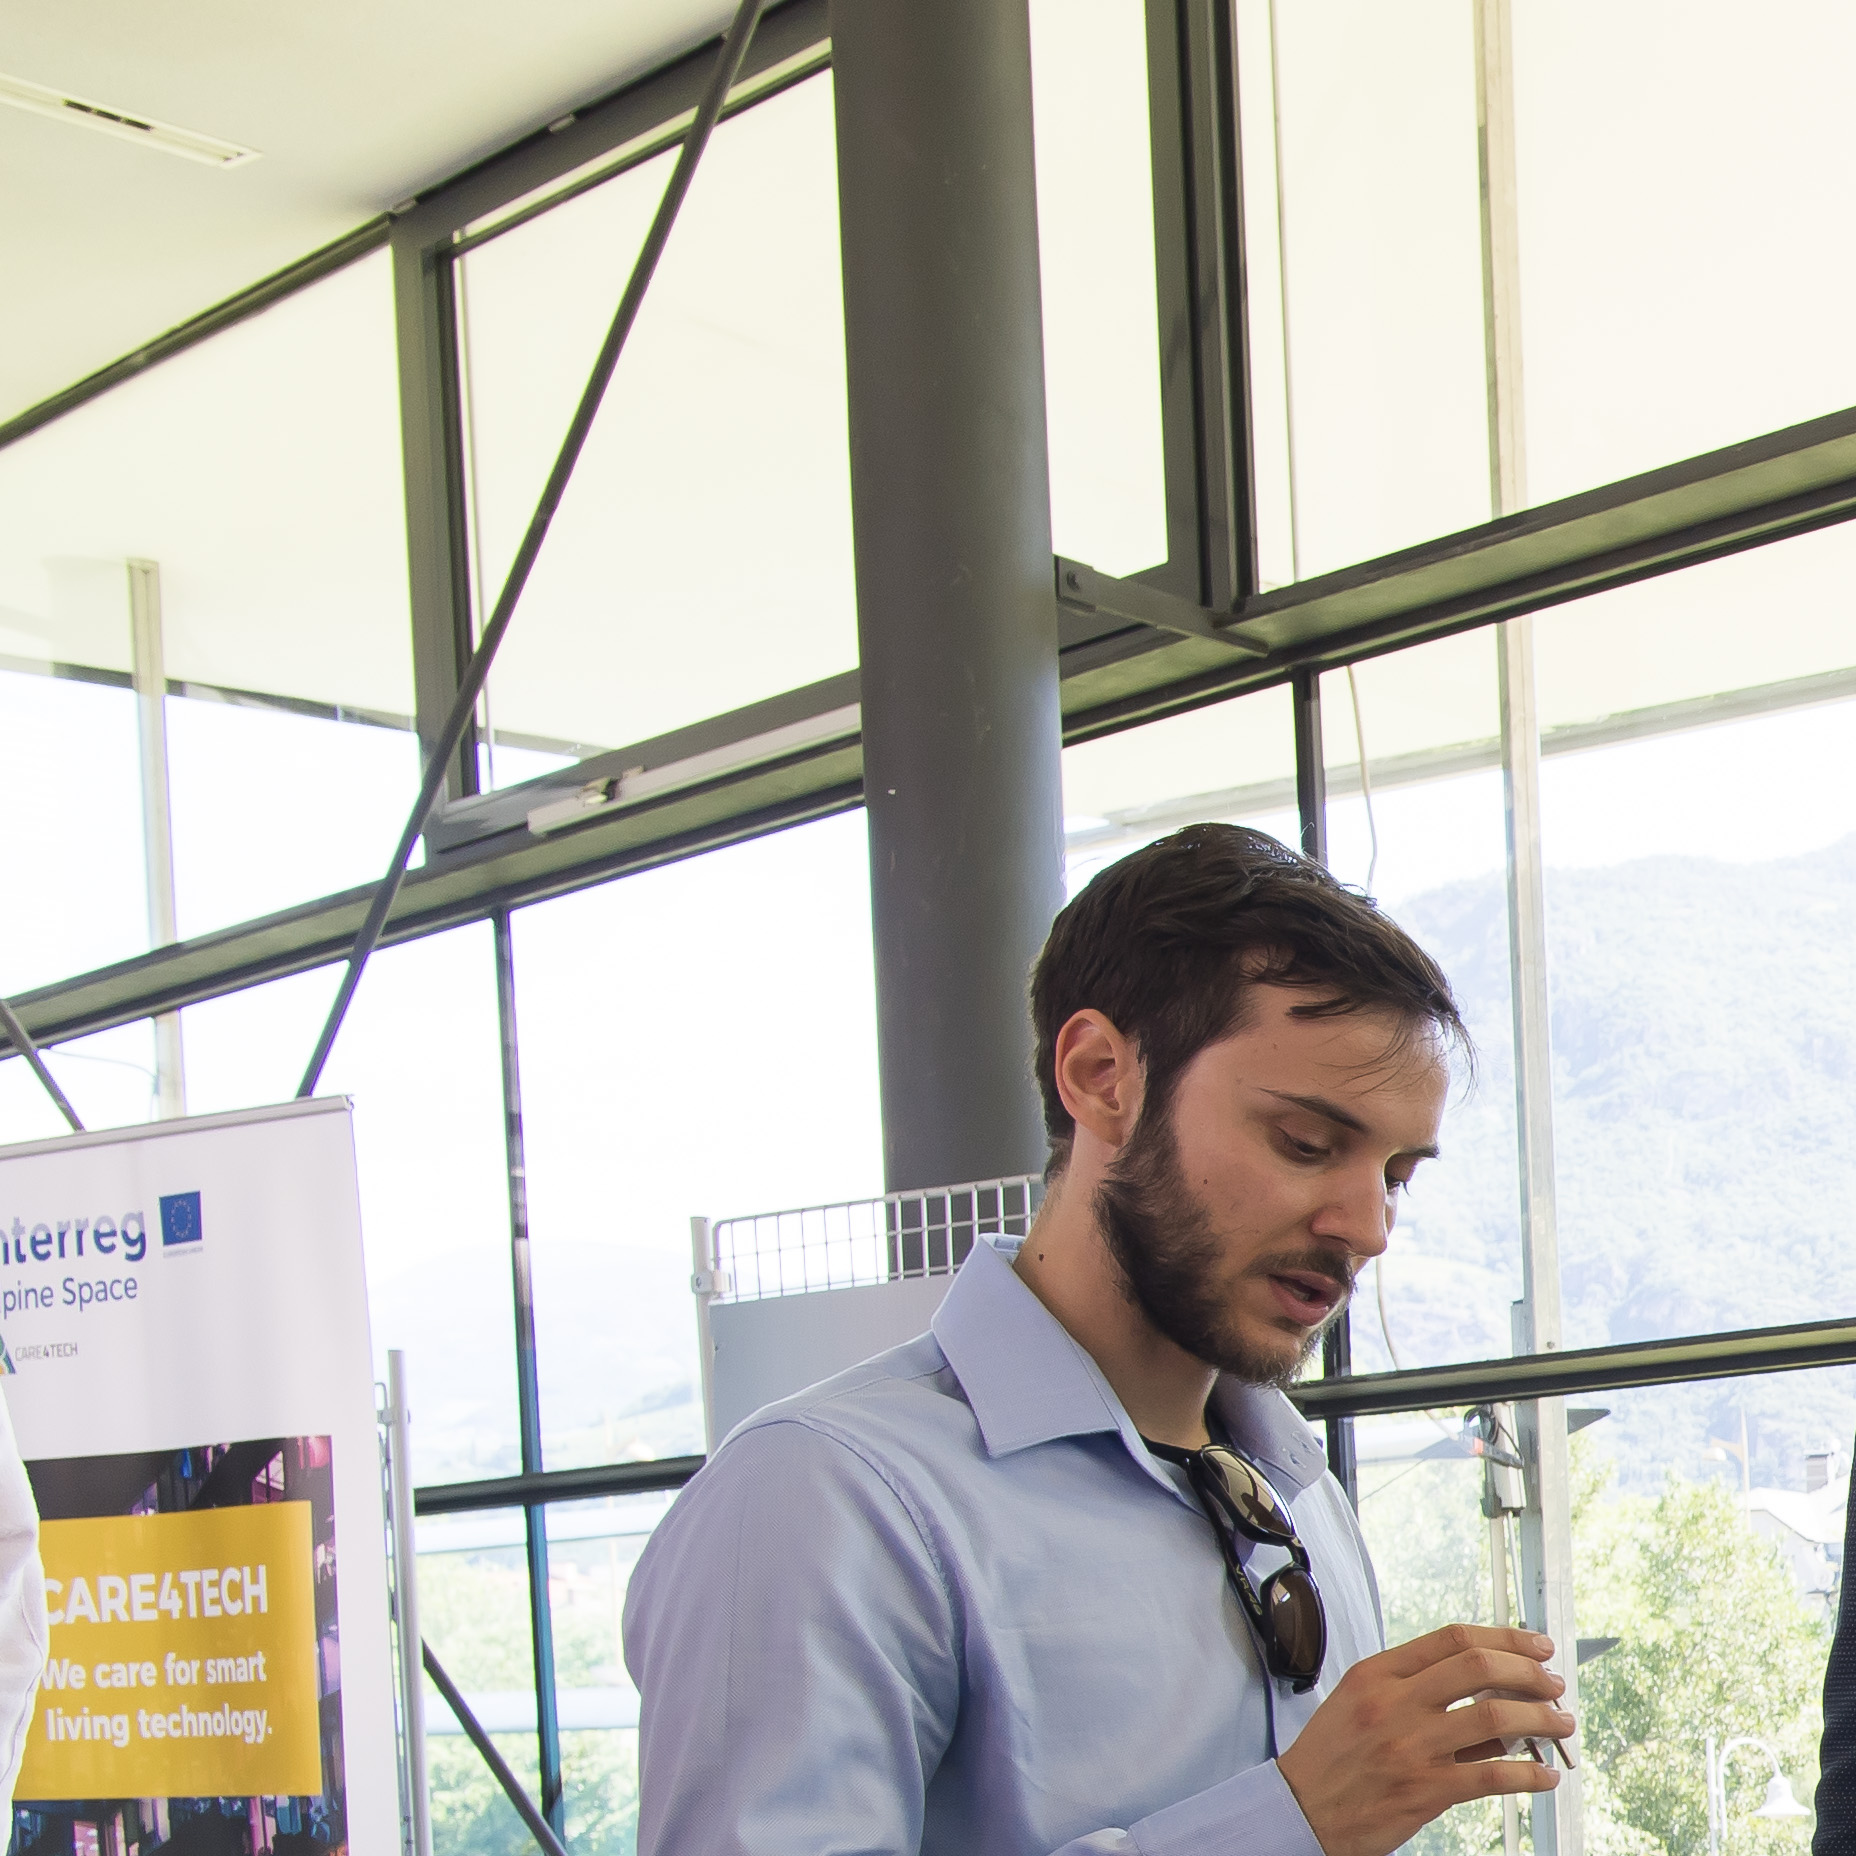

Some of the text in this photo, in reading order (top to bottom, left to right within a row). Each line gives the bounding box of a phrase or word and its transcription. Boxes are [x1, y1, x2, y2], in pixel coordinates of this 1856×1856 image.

[0, 1211, 147, 1264] terreg
[3, 1277, 138, 1319] pine Space
[15, 1343, 78, 1361] CARE4TECH
[45, 1564, 268, 1626] CARE4TECH
[42, 1650, 267, 1690] We care for smart
[46, 1702, 273, 1748] living technology.
